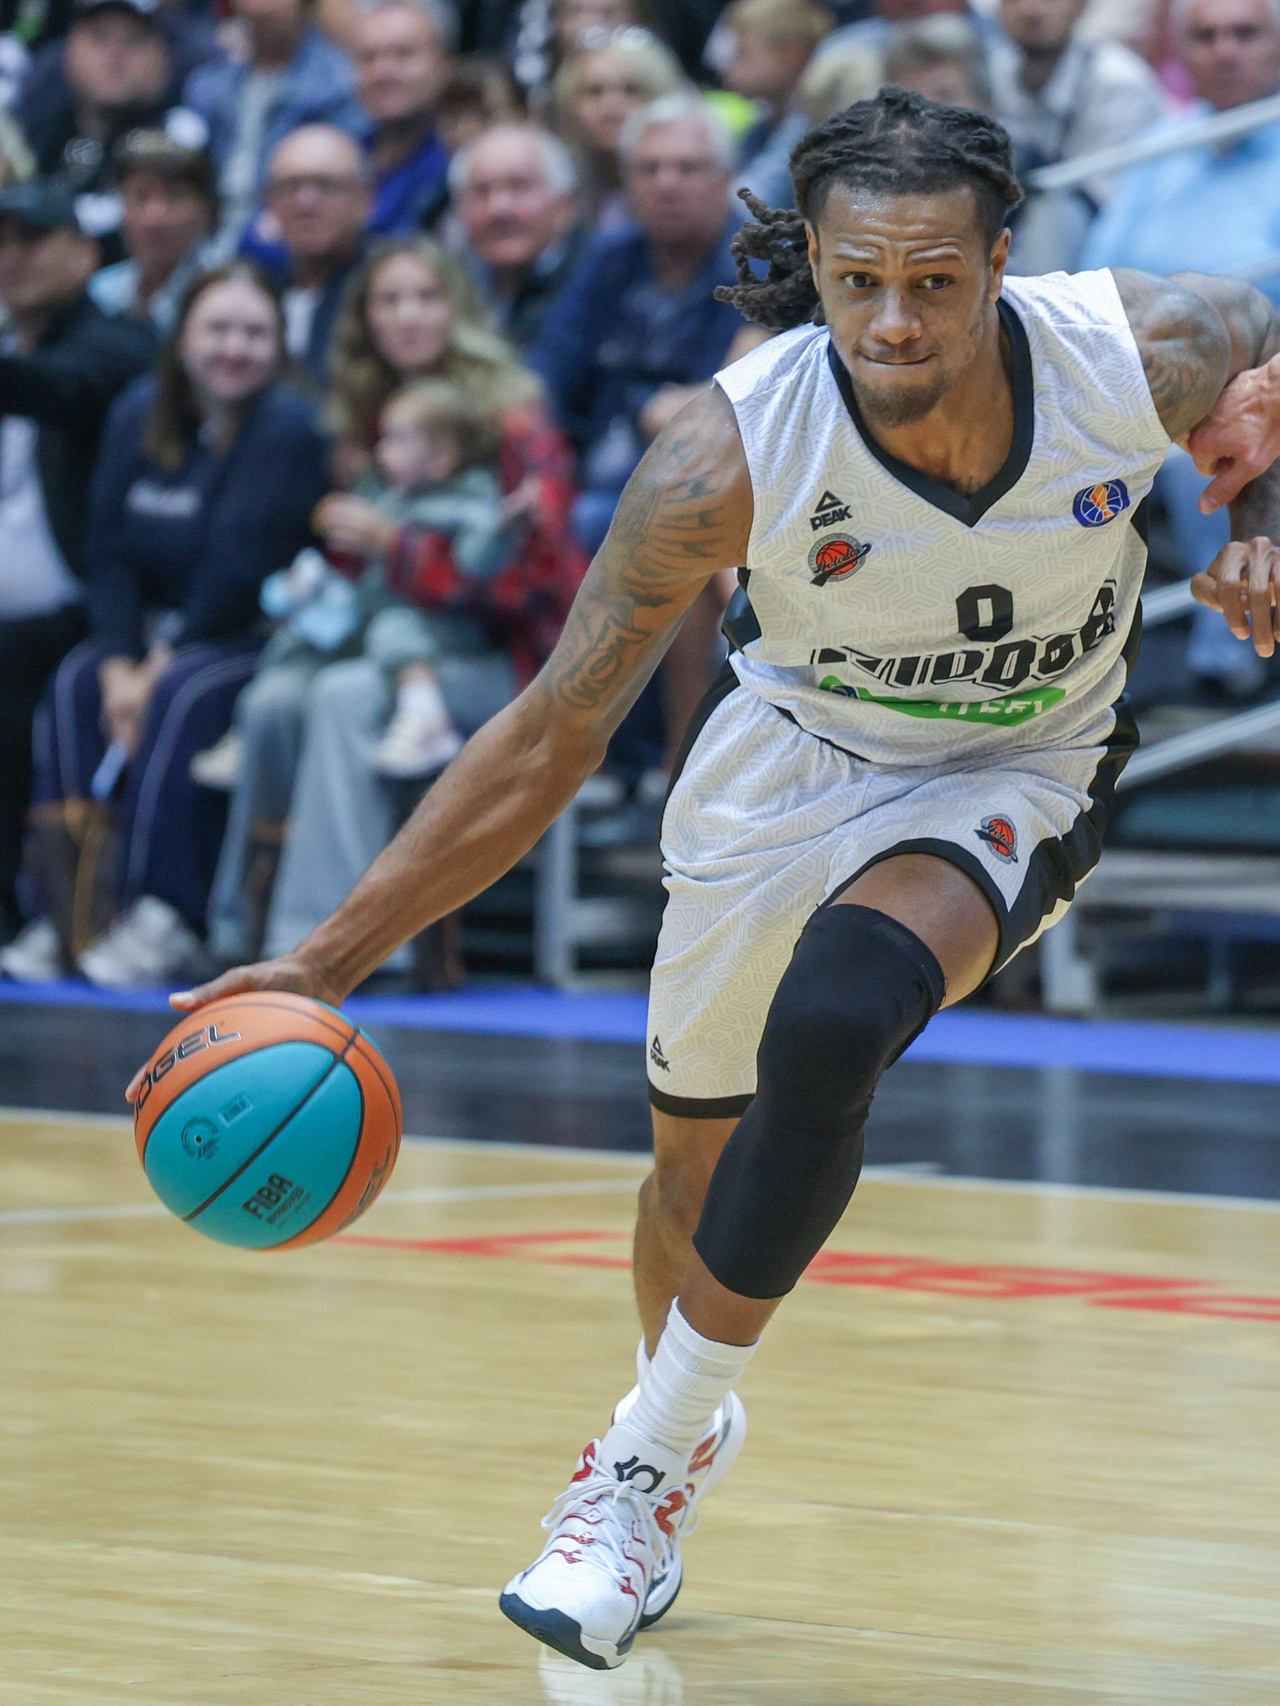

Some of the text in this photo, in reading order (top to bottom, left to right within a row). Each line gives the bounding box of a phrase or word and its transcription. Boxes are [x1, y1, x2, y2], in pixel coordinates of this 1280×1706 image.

[809, 504, 853, 532] PEAK
[135, 1023, 242, 1117] OGEL
[242, 1172, 294, 1220] FIBA
